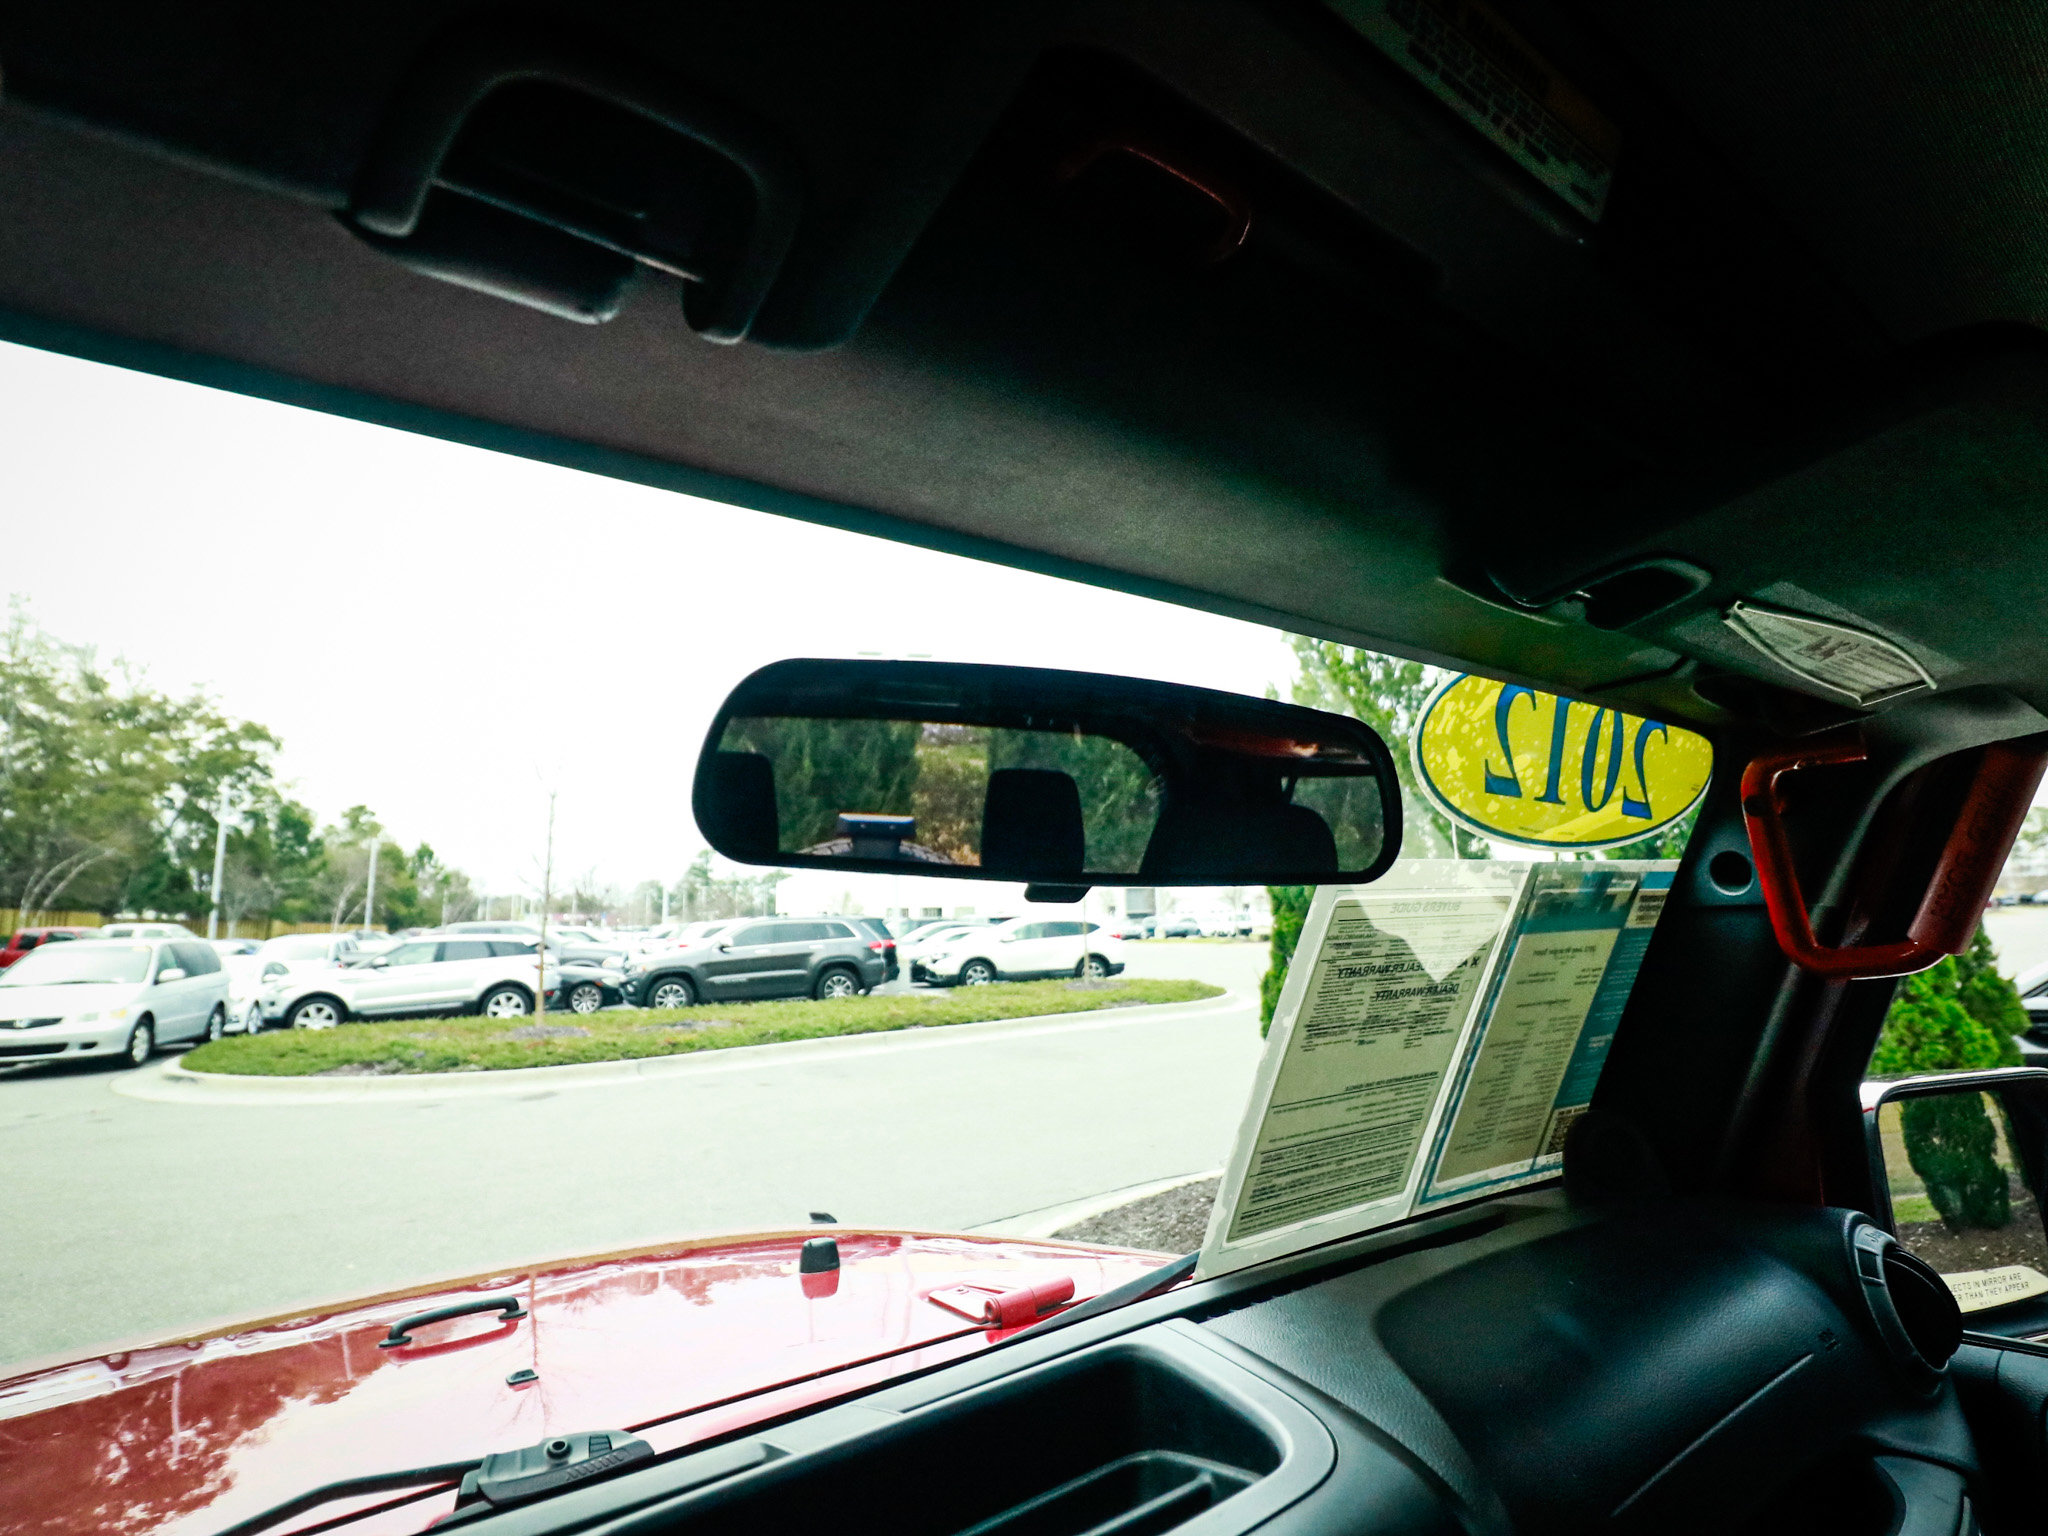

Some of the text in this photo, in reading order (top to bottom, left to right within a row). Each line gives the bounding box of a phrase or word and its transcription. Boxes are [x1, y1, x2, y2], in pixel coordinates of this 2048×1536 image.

[1981, 1275, 2006, 1286] MIRROR
[1965, 1291, 1983, 1300] THAN
[1986, 1287, 2001, 1297] THEY
[2004, 1281, 2029, 1293] APPEAR
